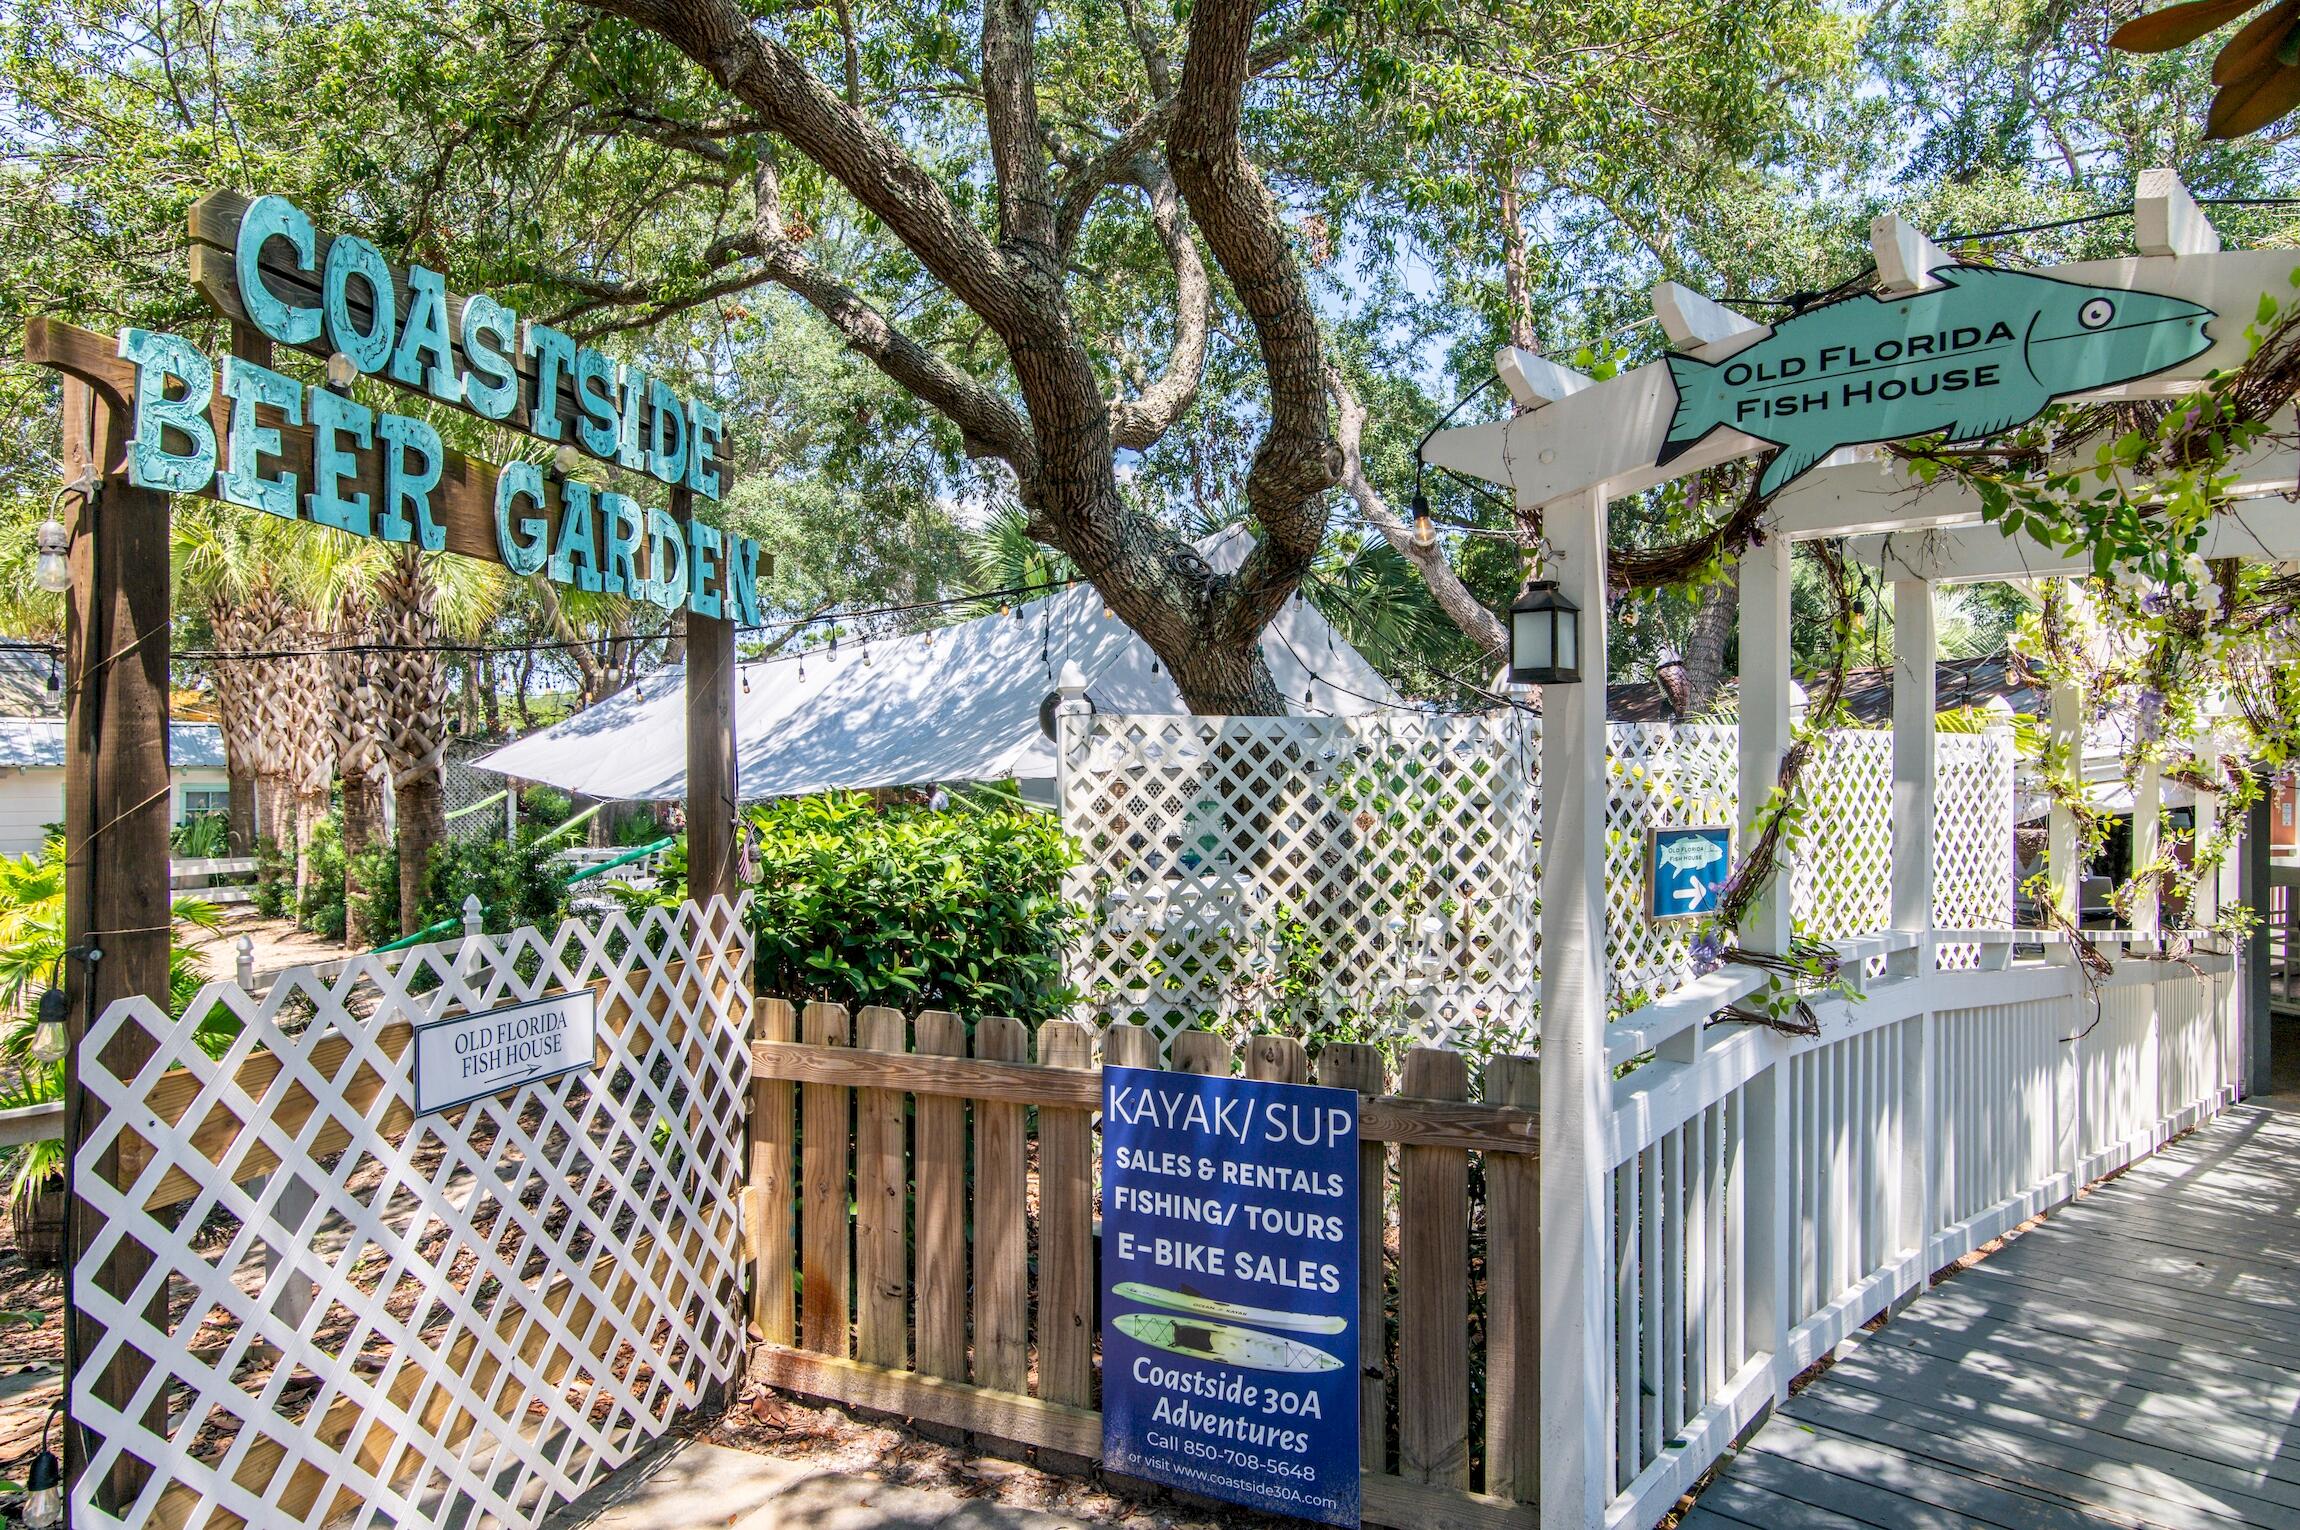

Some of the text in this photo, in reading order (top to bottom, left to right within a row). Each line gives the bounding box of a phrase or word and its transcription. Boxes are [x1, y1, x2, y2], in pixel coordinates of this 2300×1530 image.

[235, 194, 724, 500] COASTSIDE
[1722, 320, 2017, 386] OLD FLORIDA
[1735, 364, 2001, 423] FISH HOUSE
[118, 327, 762, 628] BEER GARDEN
[455, 1011, 568, 1054] OLD FLORIDA
[462, 1033, 562, 1078] FISH HOUSE
[1109, 1084, 1352, 1149] KAYAK/ SUP
[1116, 1146, 1344, 1198] SALES & RENTALS
[1114, 1185, 1344, 1242] FISHING/ TOURS
[1118, 1232, 1340, 1293] E-BIKE SALES
[1192, 1302, 1215, 1310] OCEAN
[1132, 1356, 1322, 1420] Coastside 30A
[1151, 1396, 1309, 1454] Adventures
[1128, 1452, 1338, 1509] or visit www.coastside30A.com
[1146, 1431, 1316, 1482] Call 850-708-5648
